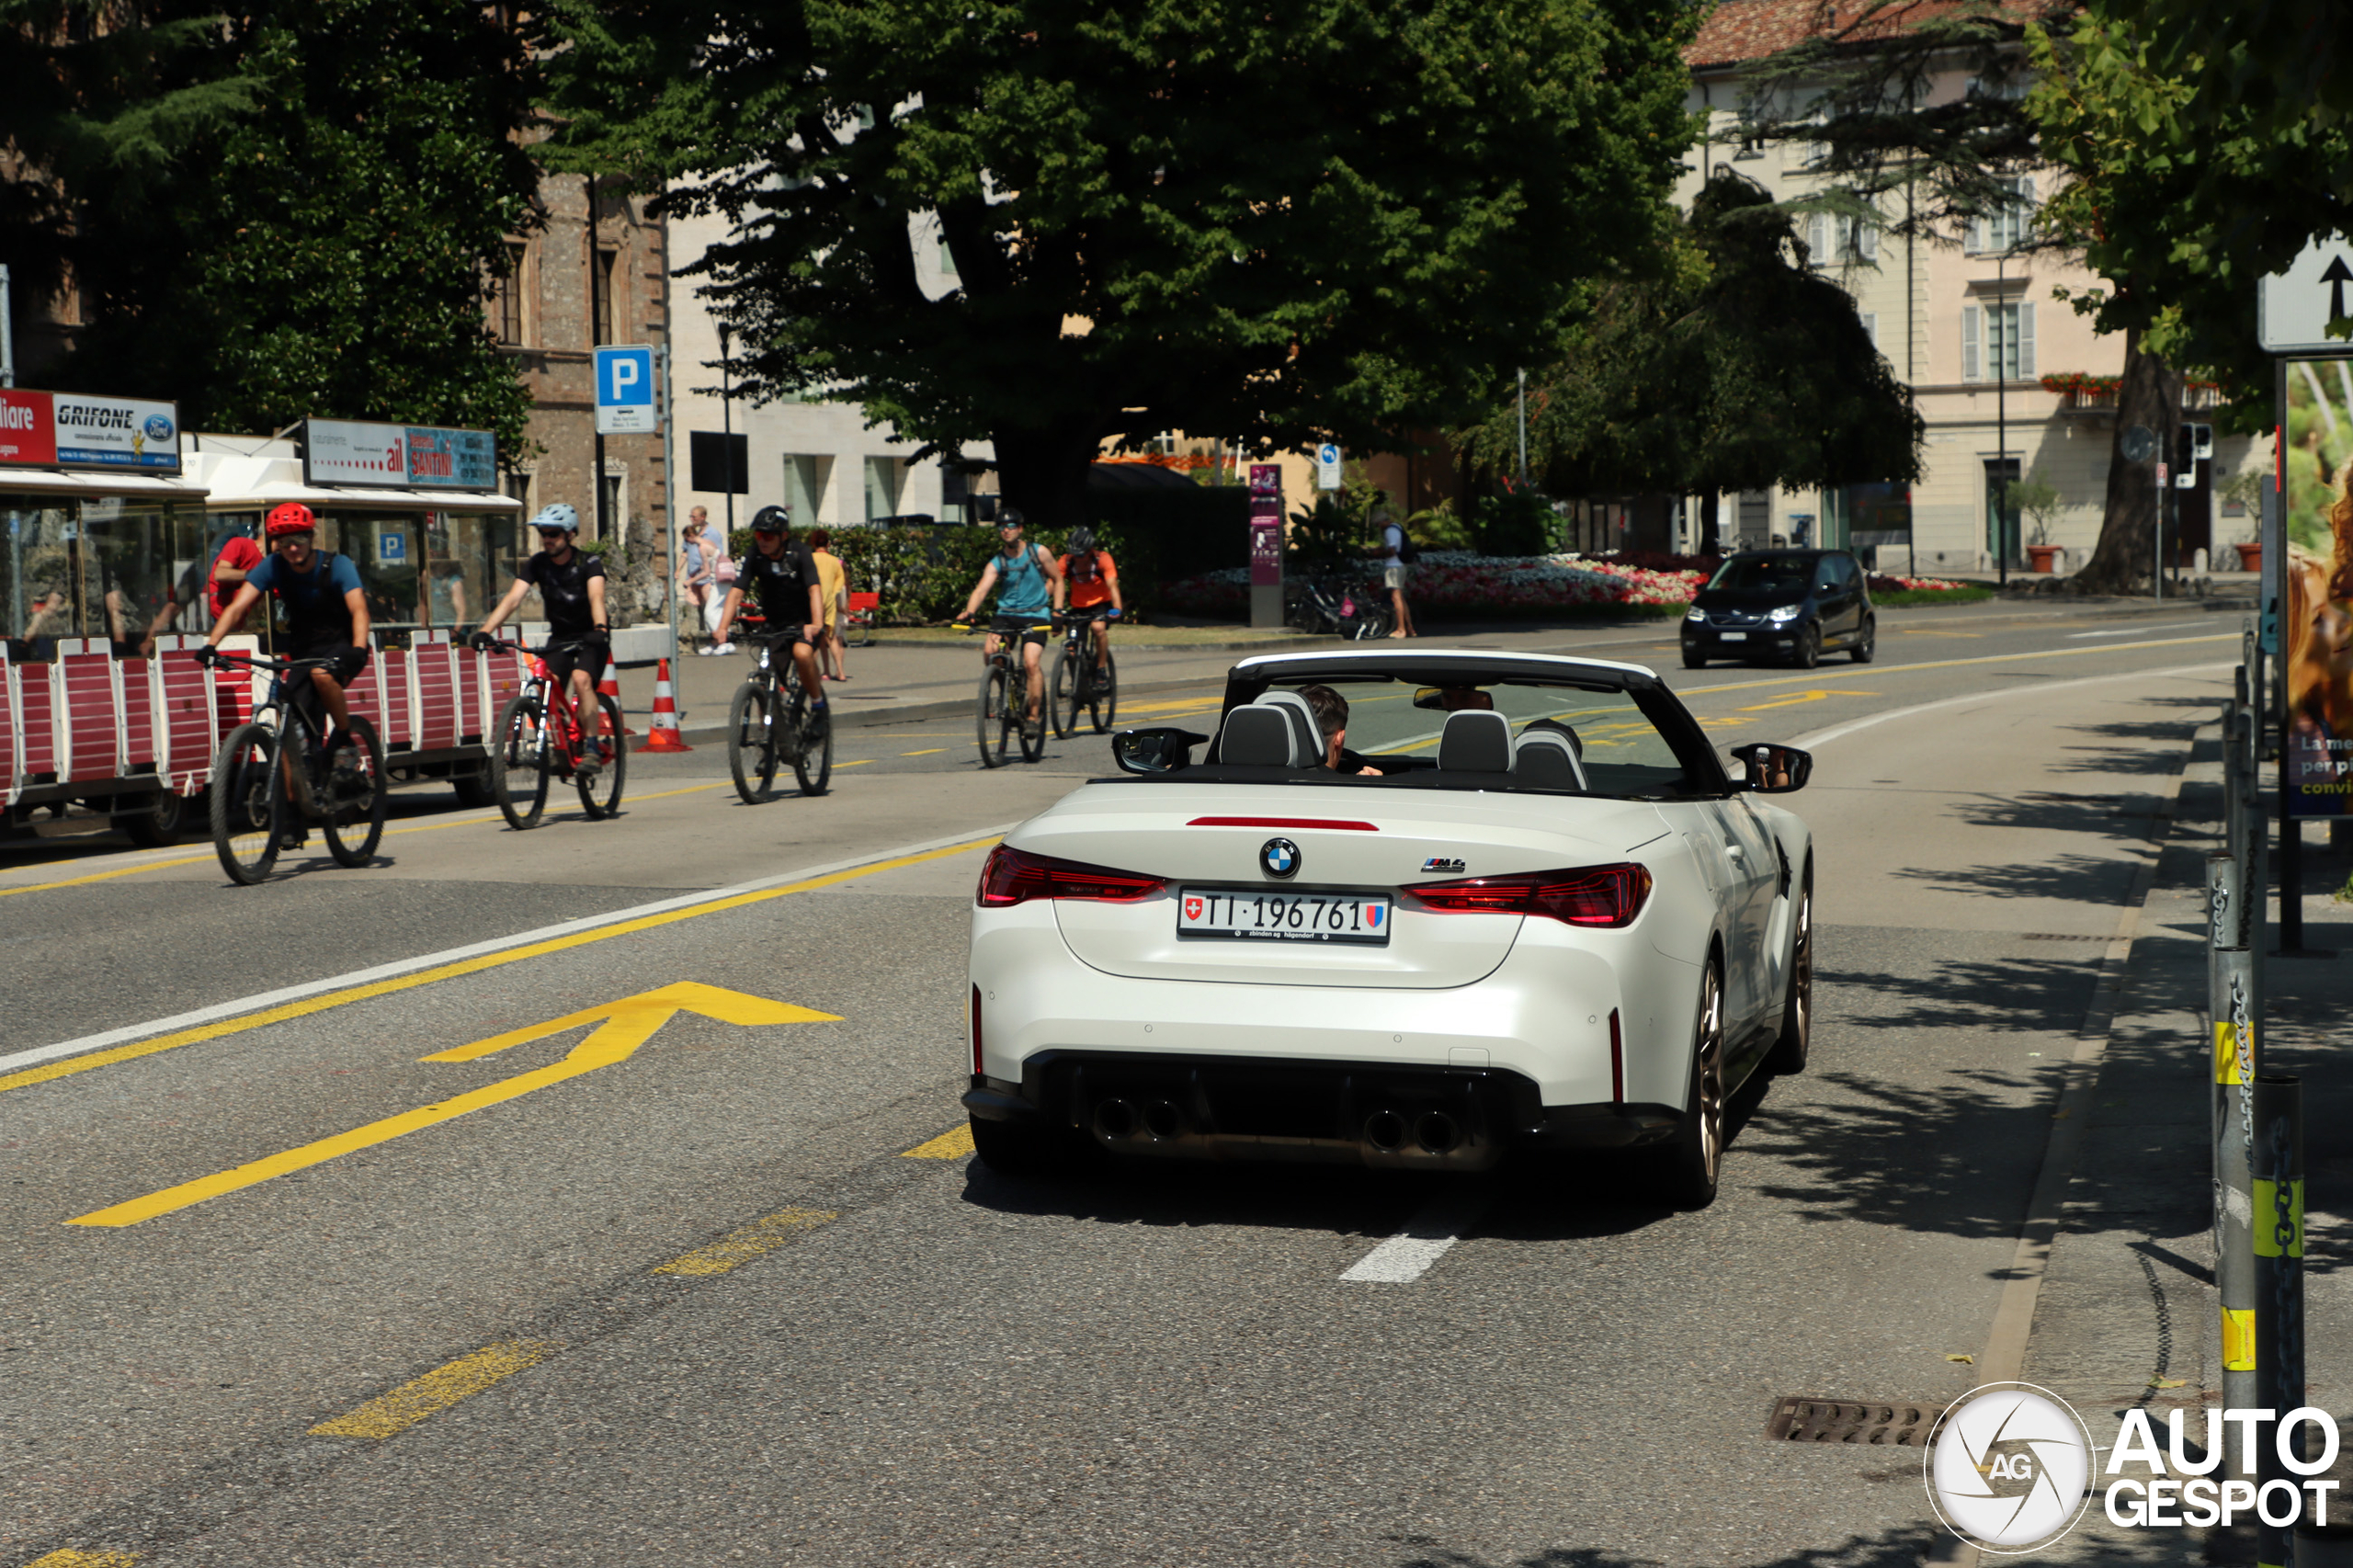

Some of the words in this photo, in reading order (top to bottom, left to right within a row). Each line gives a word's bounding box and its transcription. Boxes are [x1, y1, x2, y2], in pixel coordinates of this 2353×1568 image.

[612, 358, 639, 401] P
[58, 404, 134, 429] GRIFONE
[150, 418, 169, 437] Ford
[387, 437, 404, 472] ail
[412, 450, 453, 476] SANTINI
[386, 537, 398, 556] P
[2302, 737, 2322, 750] La
[2302, 761, 2332, 776] per
